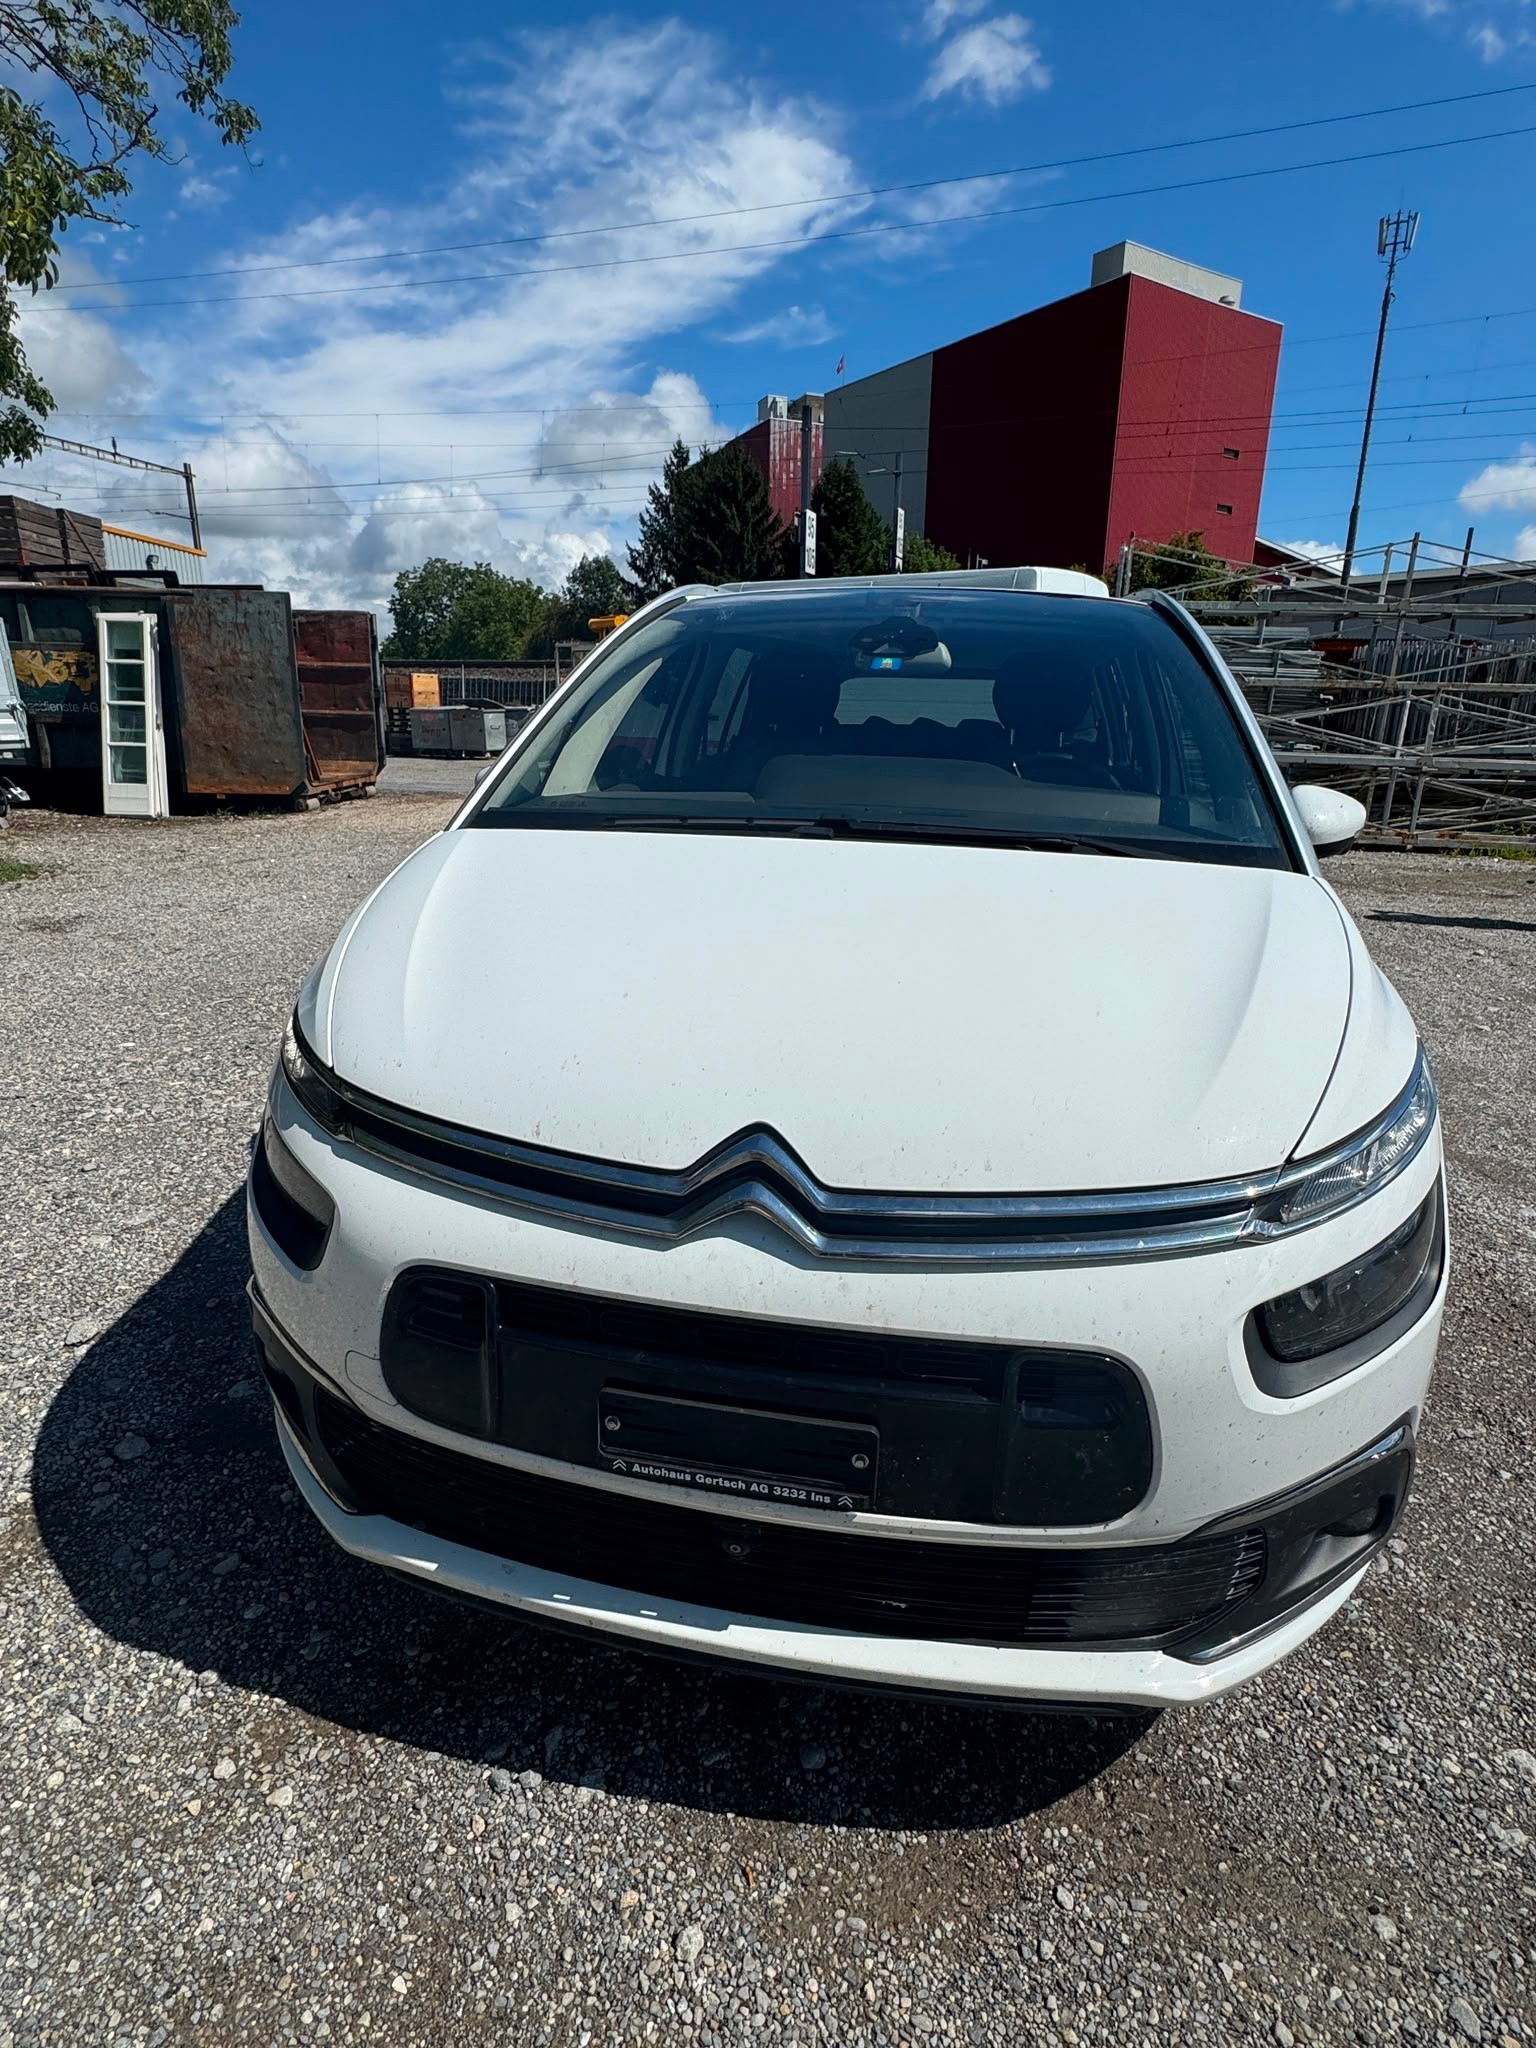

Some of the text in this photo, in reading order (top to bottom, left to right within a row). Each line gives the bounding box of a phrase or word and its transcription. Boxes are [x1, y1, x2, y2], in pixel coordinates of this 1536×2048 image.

[82, 702, 99, 713] AG
[632, 1463, 831, 1504] Autohaus Gertsch AG 3232 Ins
